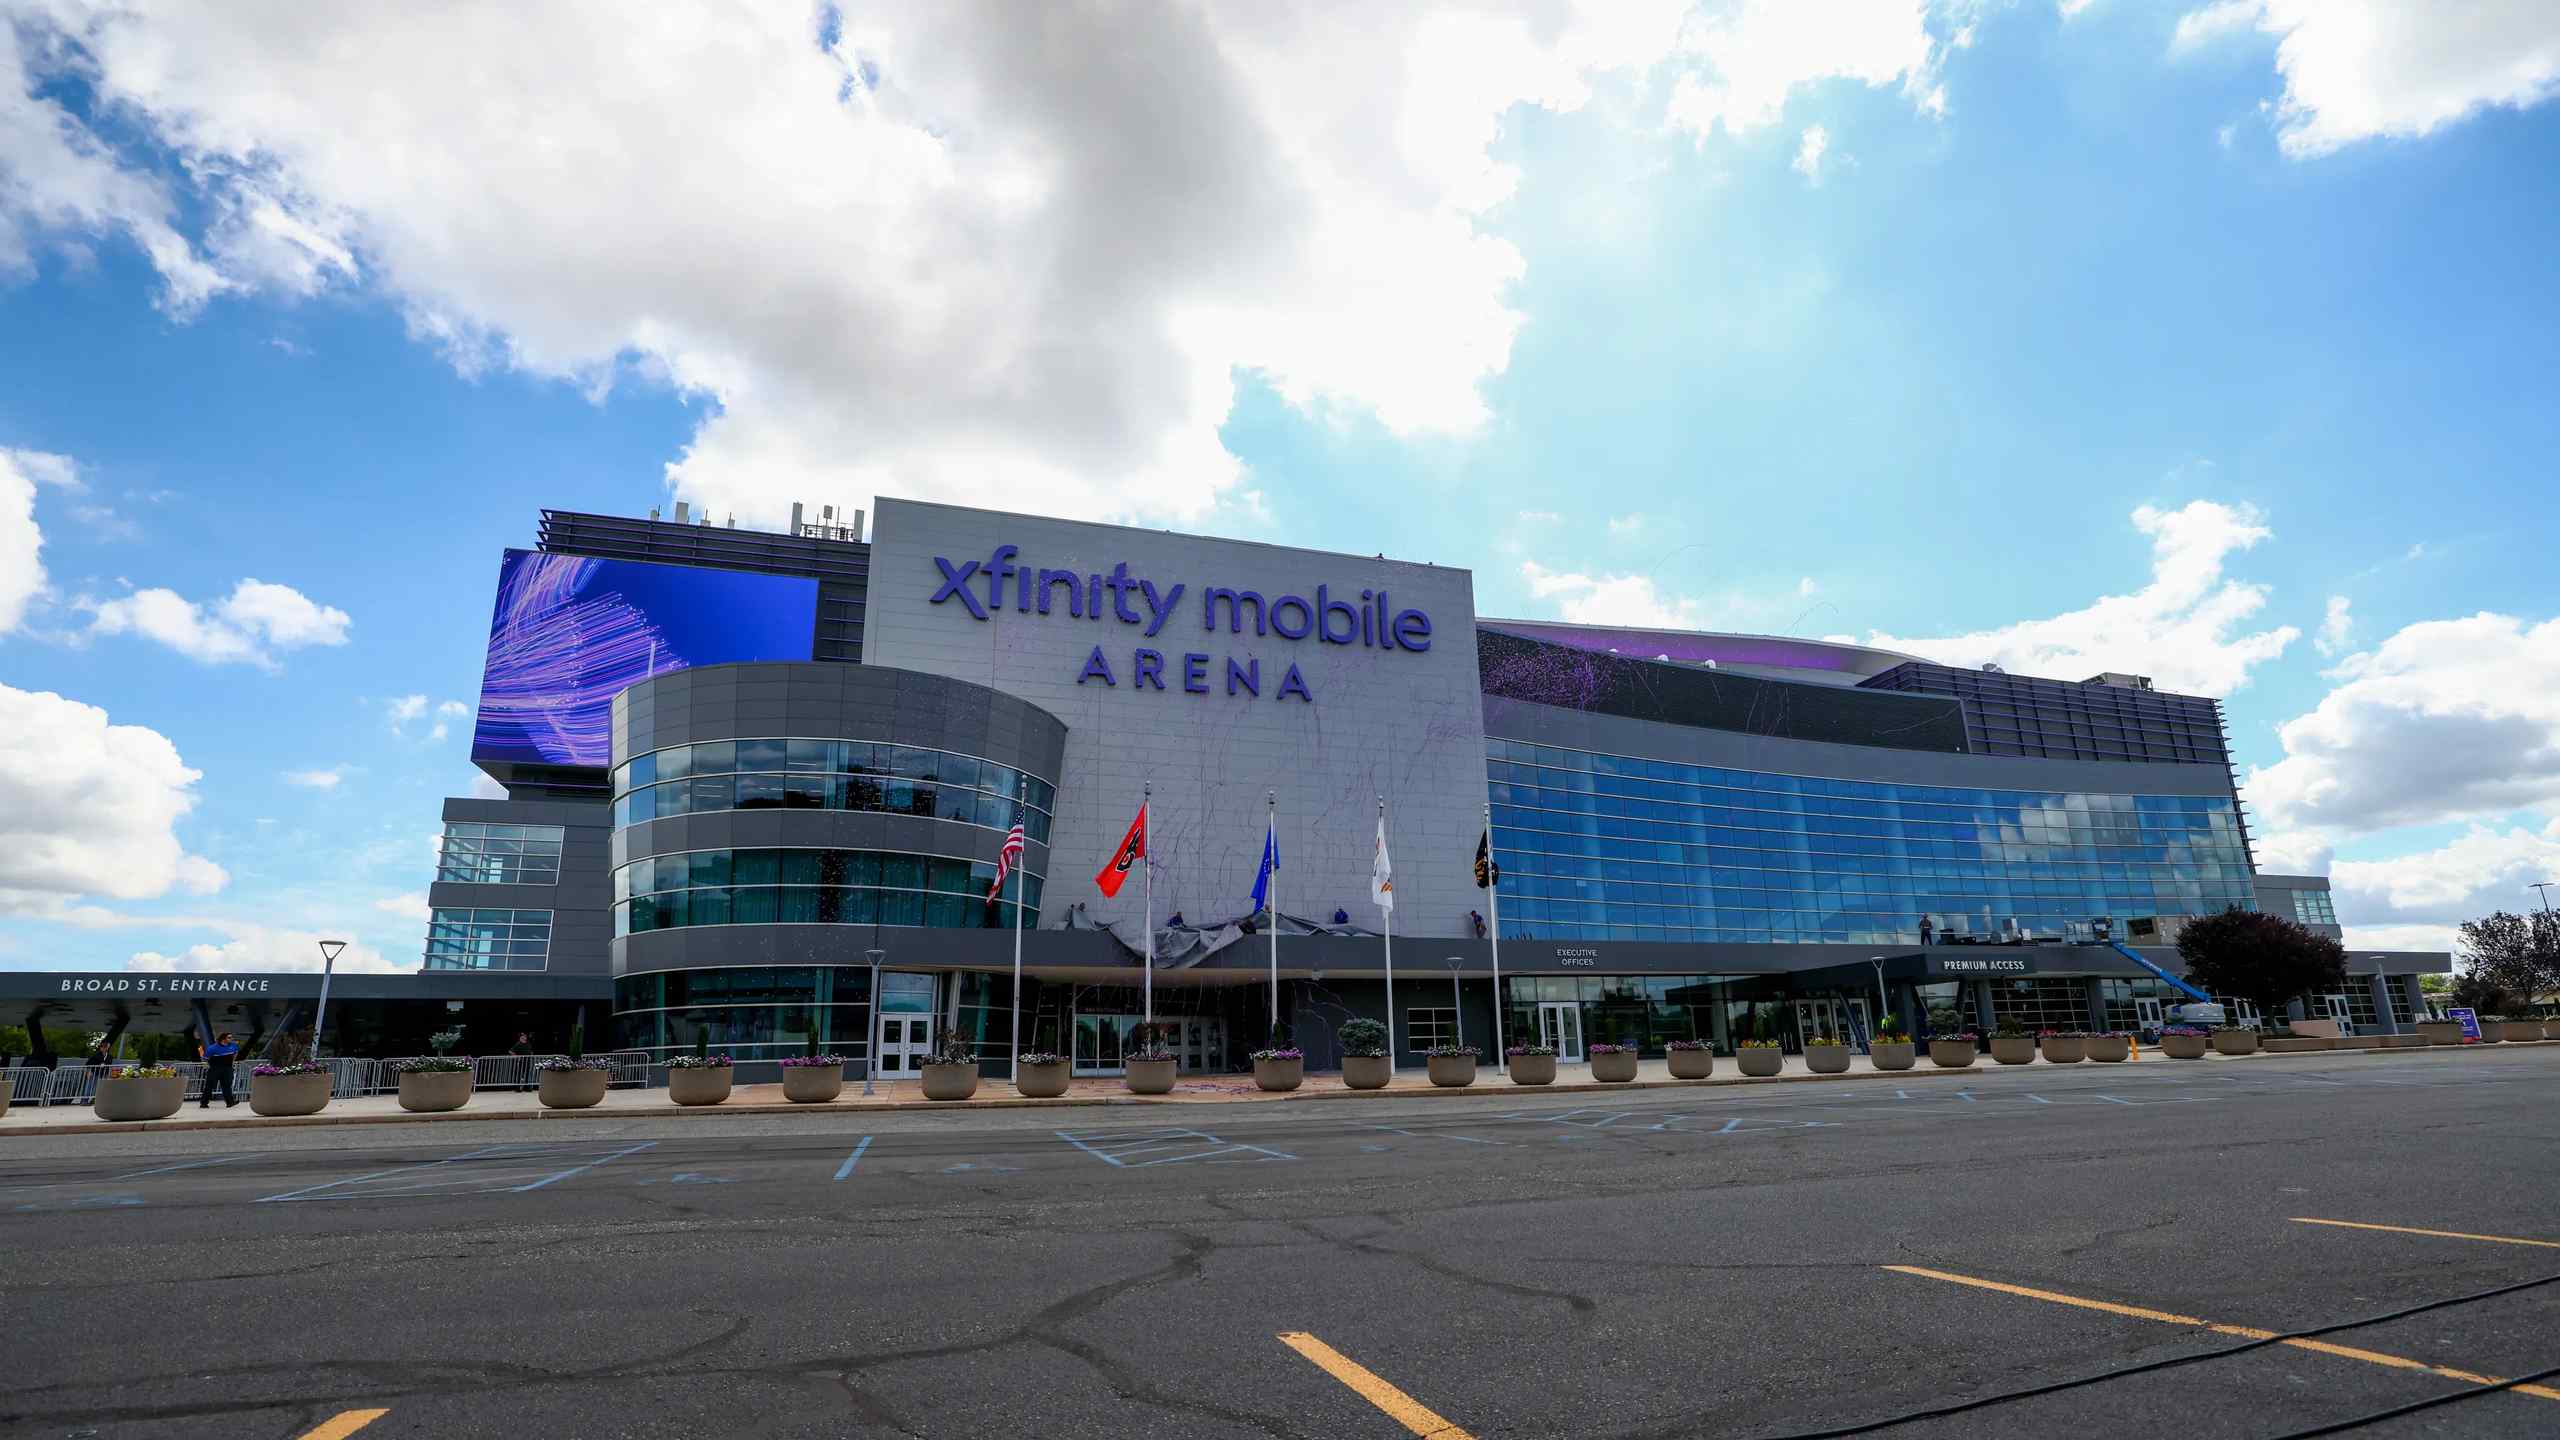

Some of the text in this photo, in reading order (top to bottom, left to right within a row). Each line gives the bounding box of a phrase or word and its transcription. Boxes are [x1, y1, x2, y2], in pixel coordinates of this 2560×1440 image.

[929, 544, 1432, 653] xfinity mobile
[1077, 645, 1313, 702] ARENA
[1556, 949, 1598, 957] EXECUTIVE
[1561, 958, 1594, 966] OFFICES
[1943, 960, 2025, 970] PREMIUM ACCESS
[61, 978, 271, 992] BROAD ST. ENTRANCE
